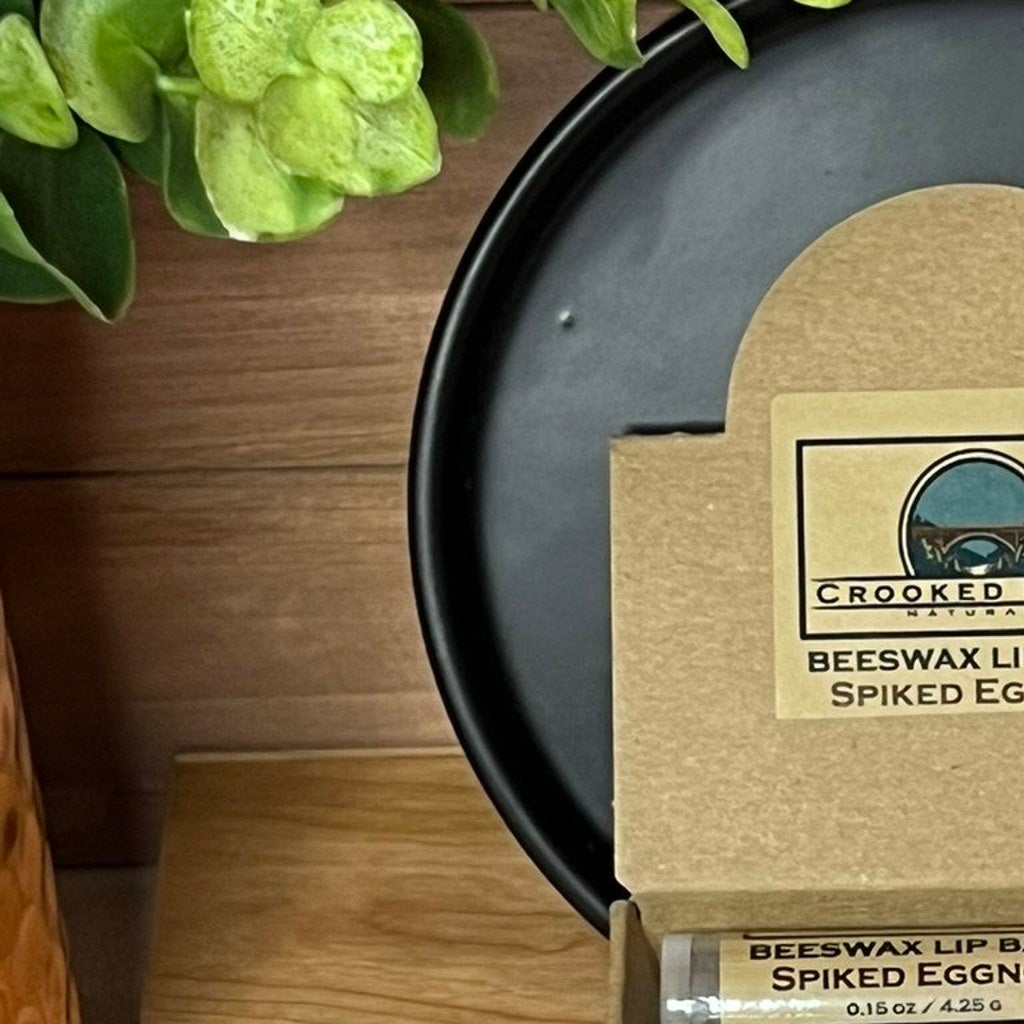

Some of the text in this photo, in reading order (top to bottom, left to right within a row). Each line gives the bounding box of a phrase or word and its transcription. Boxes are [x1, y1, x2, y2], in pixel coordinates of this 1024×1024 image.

[816, 582, 1004, 605] CROOKED
[807, 647, 981, 673] BEESWAX
[831, 681, 963, 708] SPIKED
[749, 940, 923, 960] BEESWAX
[934, 939, 989, 955] LIP
[771, 966, 906, 991] SPIKED
[846, 1002, 888, 1017] 0.15
[921, 998, 937, 1015] /
